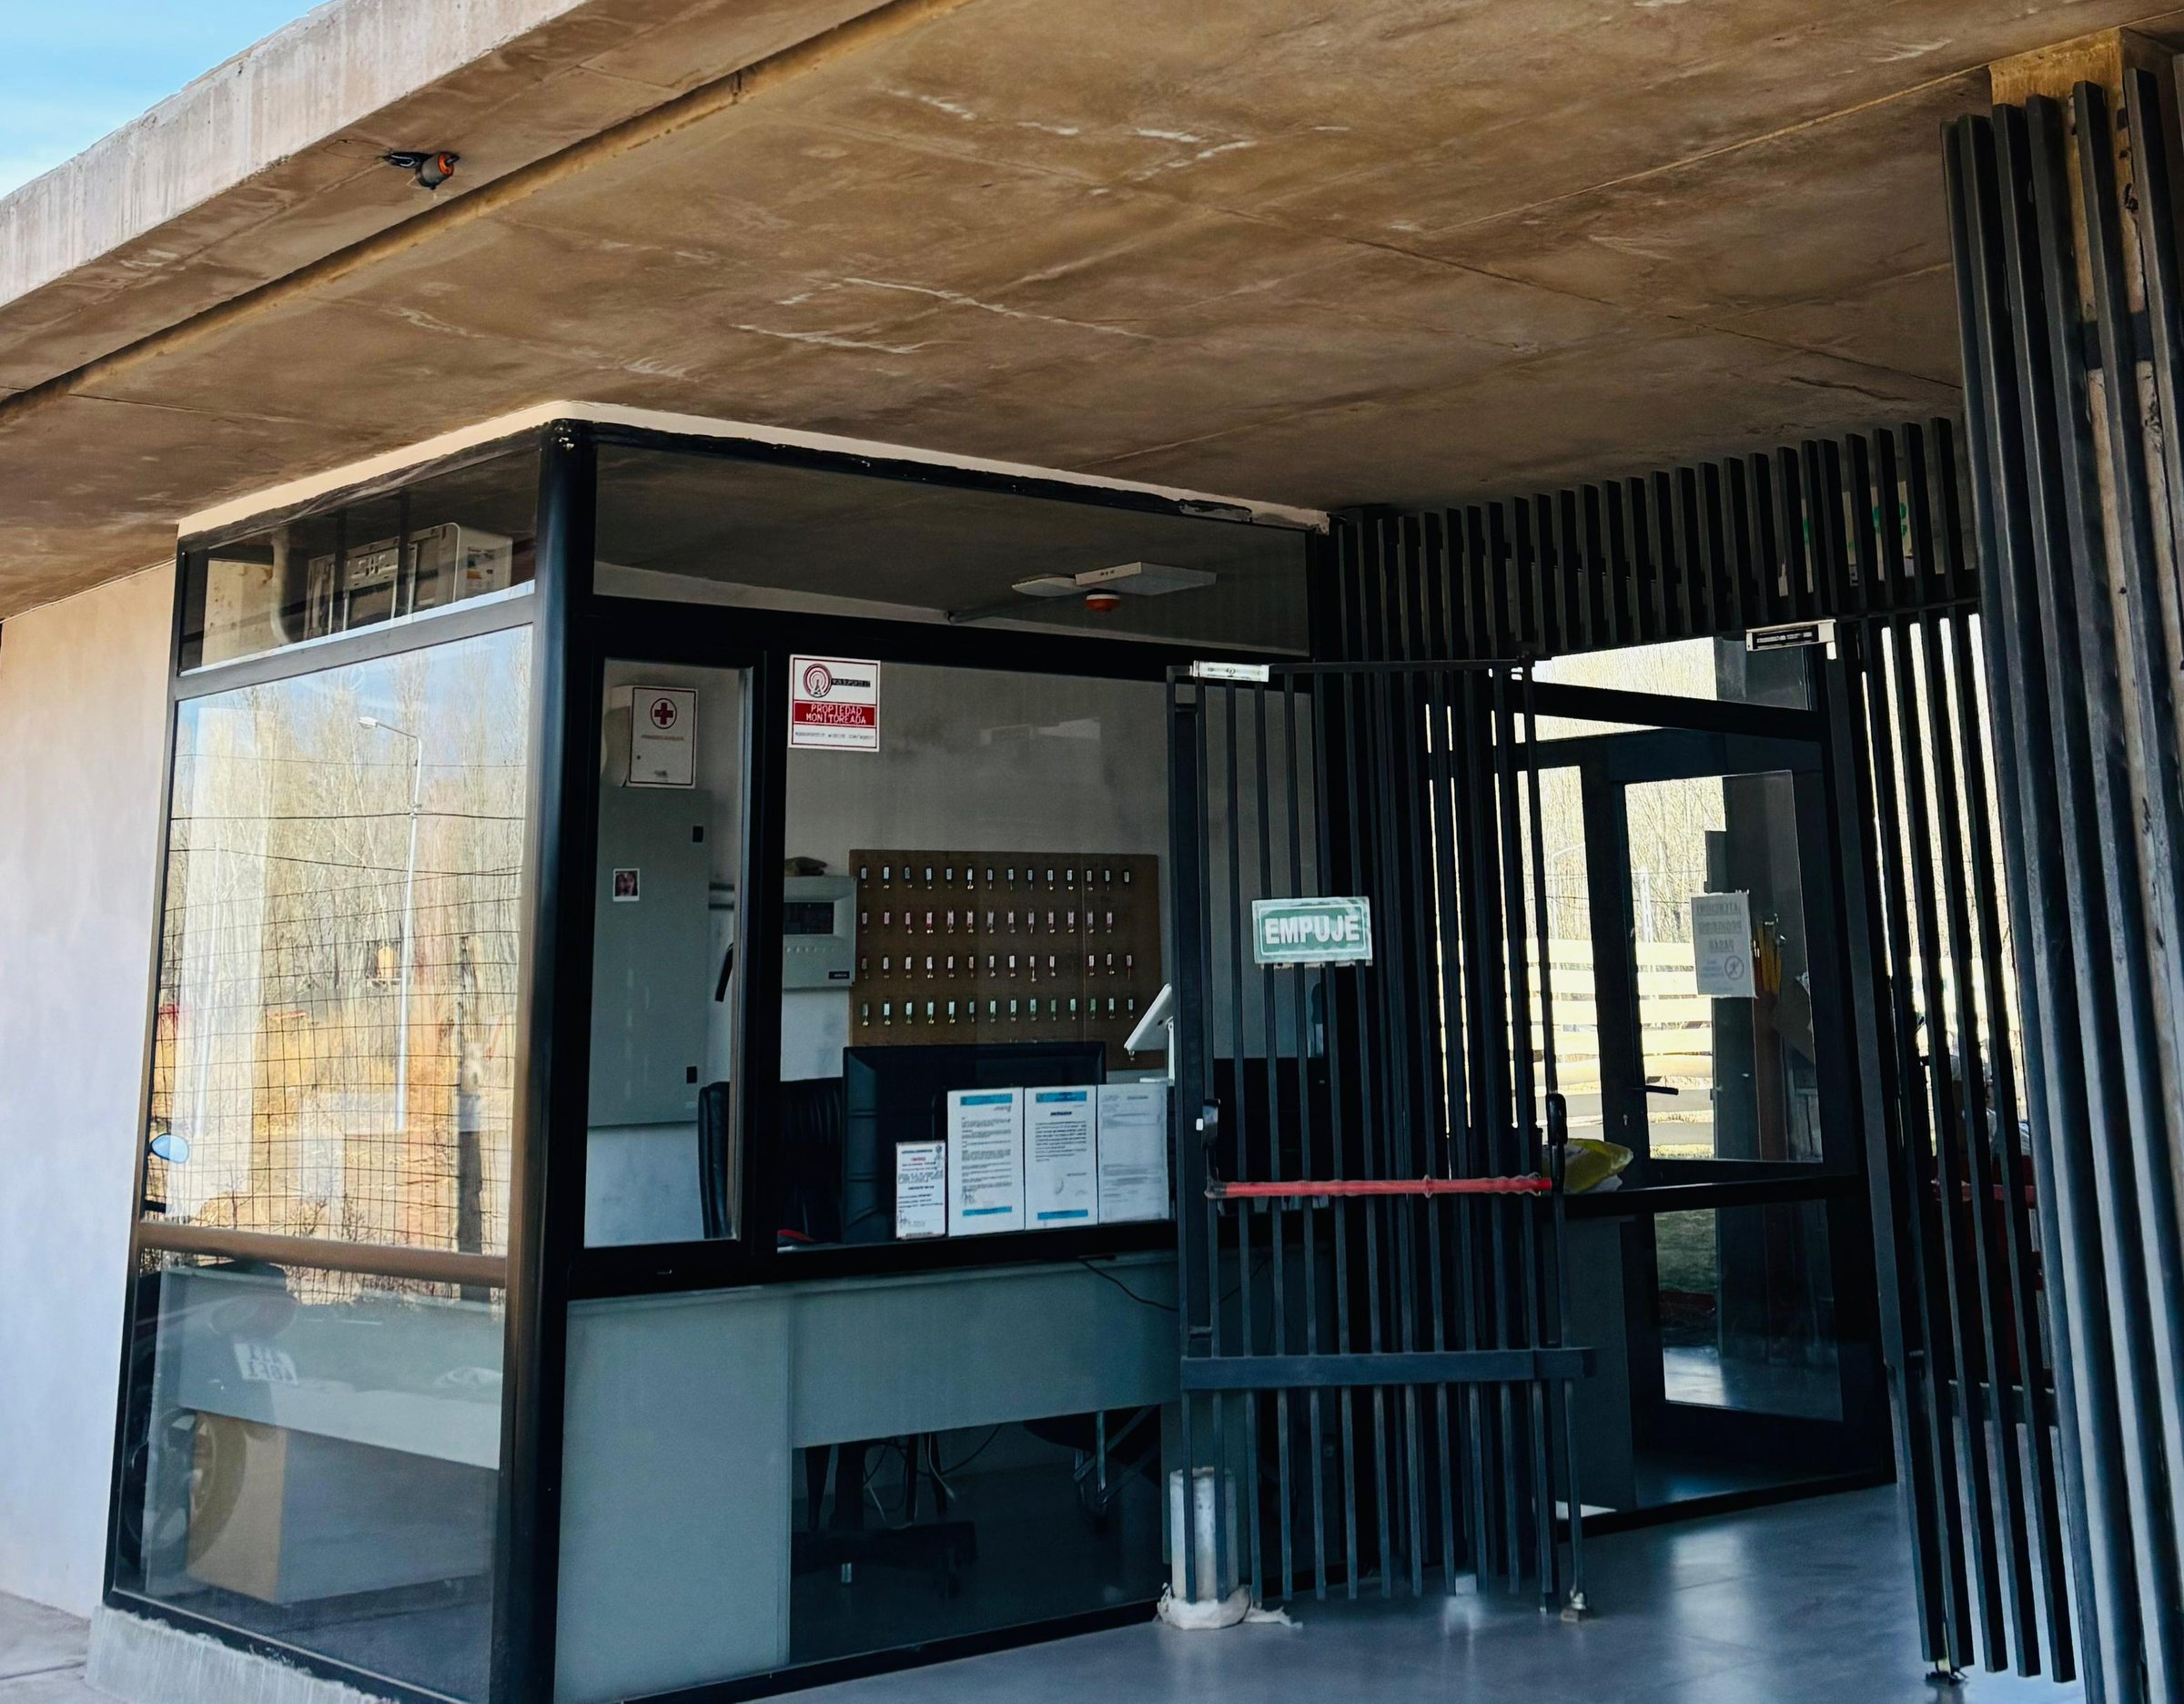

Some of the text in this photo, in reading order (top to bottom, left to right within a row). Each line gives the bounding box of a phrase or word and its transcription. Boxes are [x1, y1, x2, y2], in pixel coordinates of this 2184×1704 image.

[811, 704, 863, 715] PROPIEDAD
[805, 713, 866, 725] MONITOREADA
[1264, 914, 1360, 945] EMPUJE
